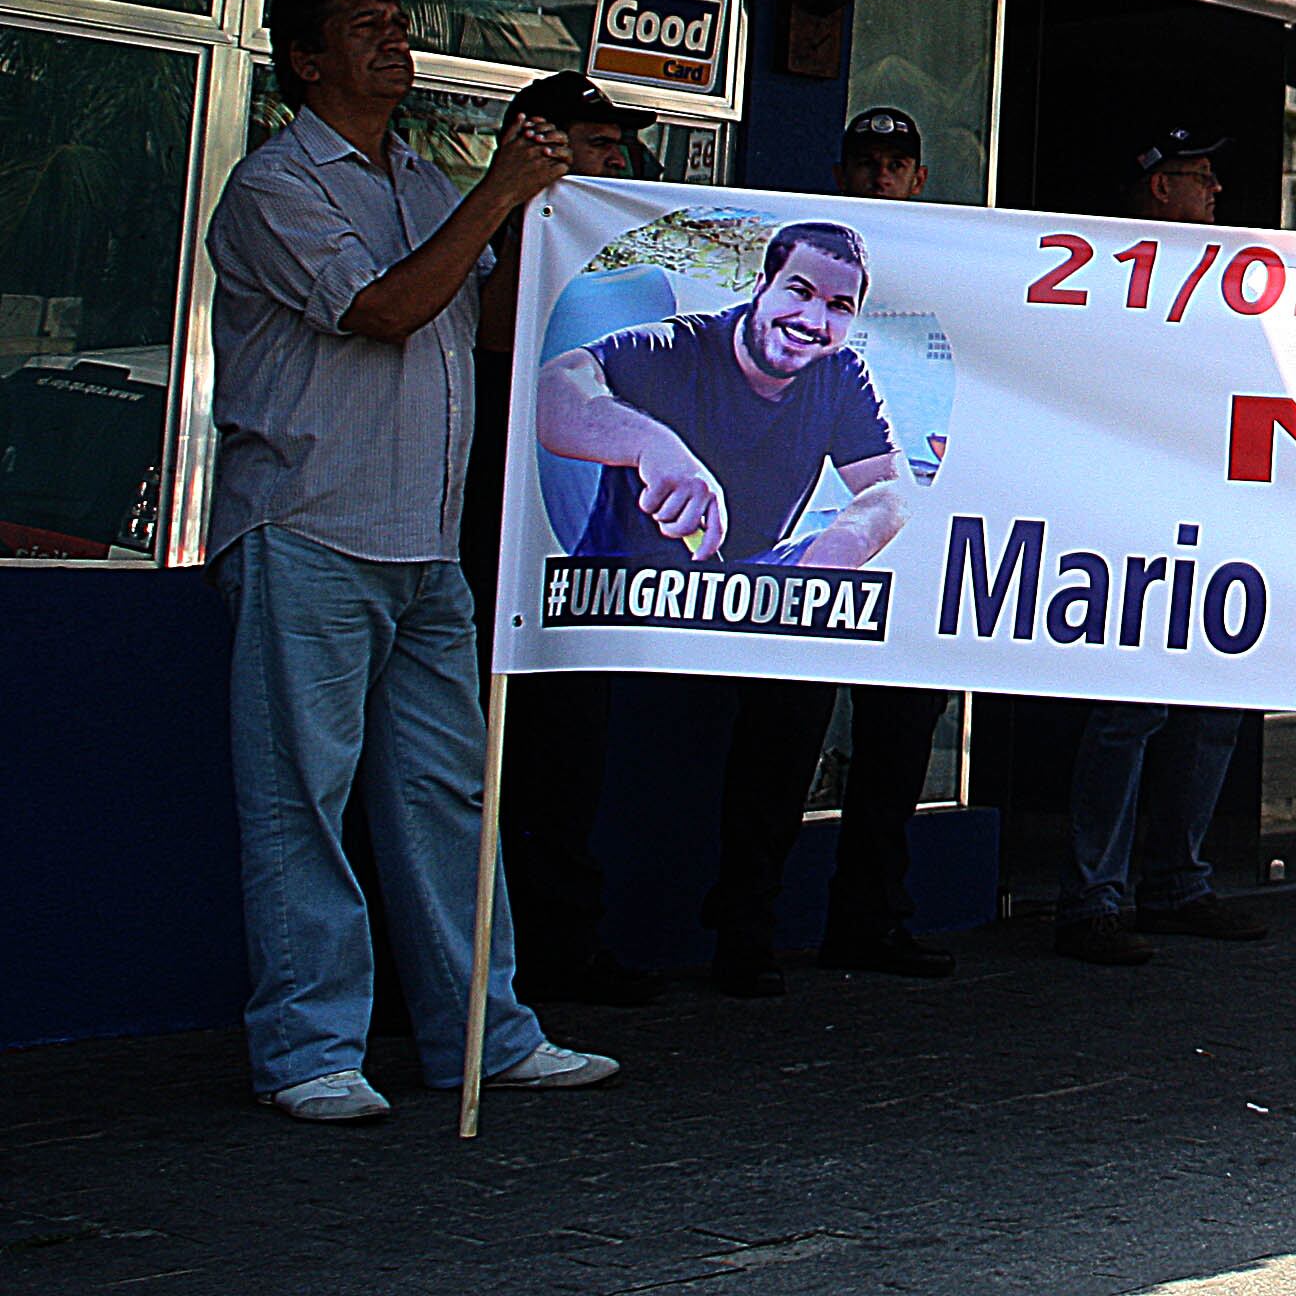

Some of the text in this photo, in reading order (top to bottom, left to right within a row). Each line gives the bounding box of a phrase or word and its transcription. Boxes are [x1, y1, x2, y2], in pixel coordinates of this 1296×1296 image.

[662, 60, 703, 82] Card
[547, 566, 884, 632] #UMGRITODEPAZ
[937, 515, 1267, 655] Mario
